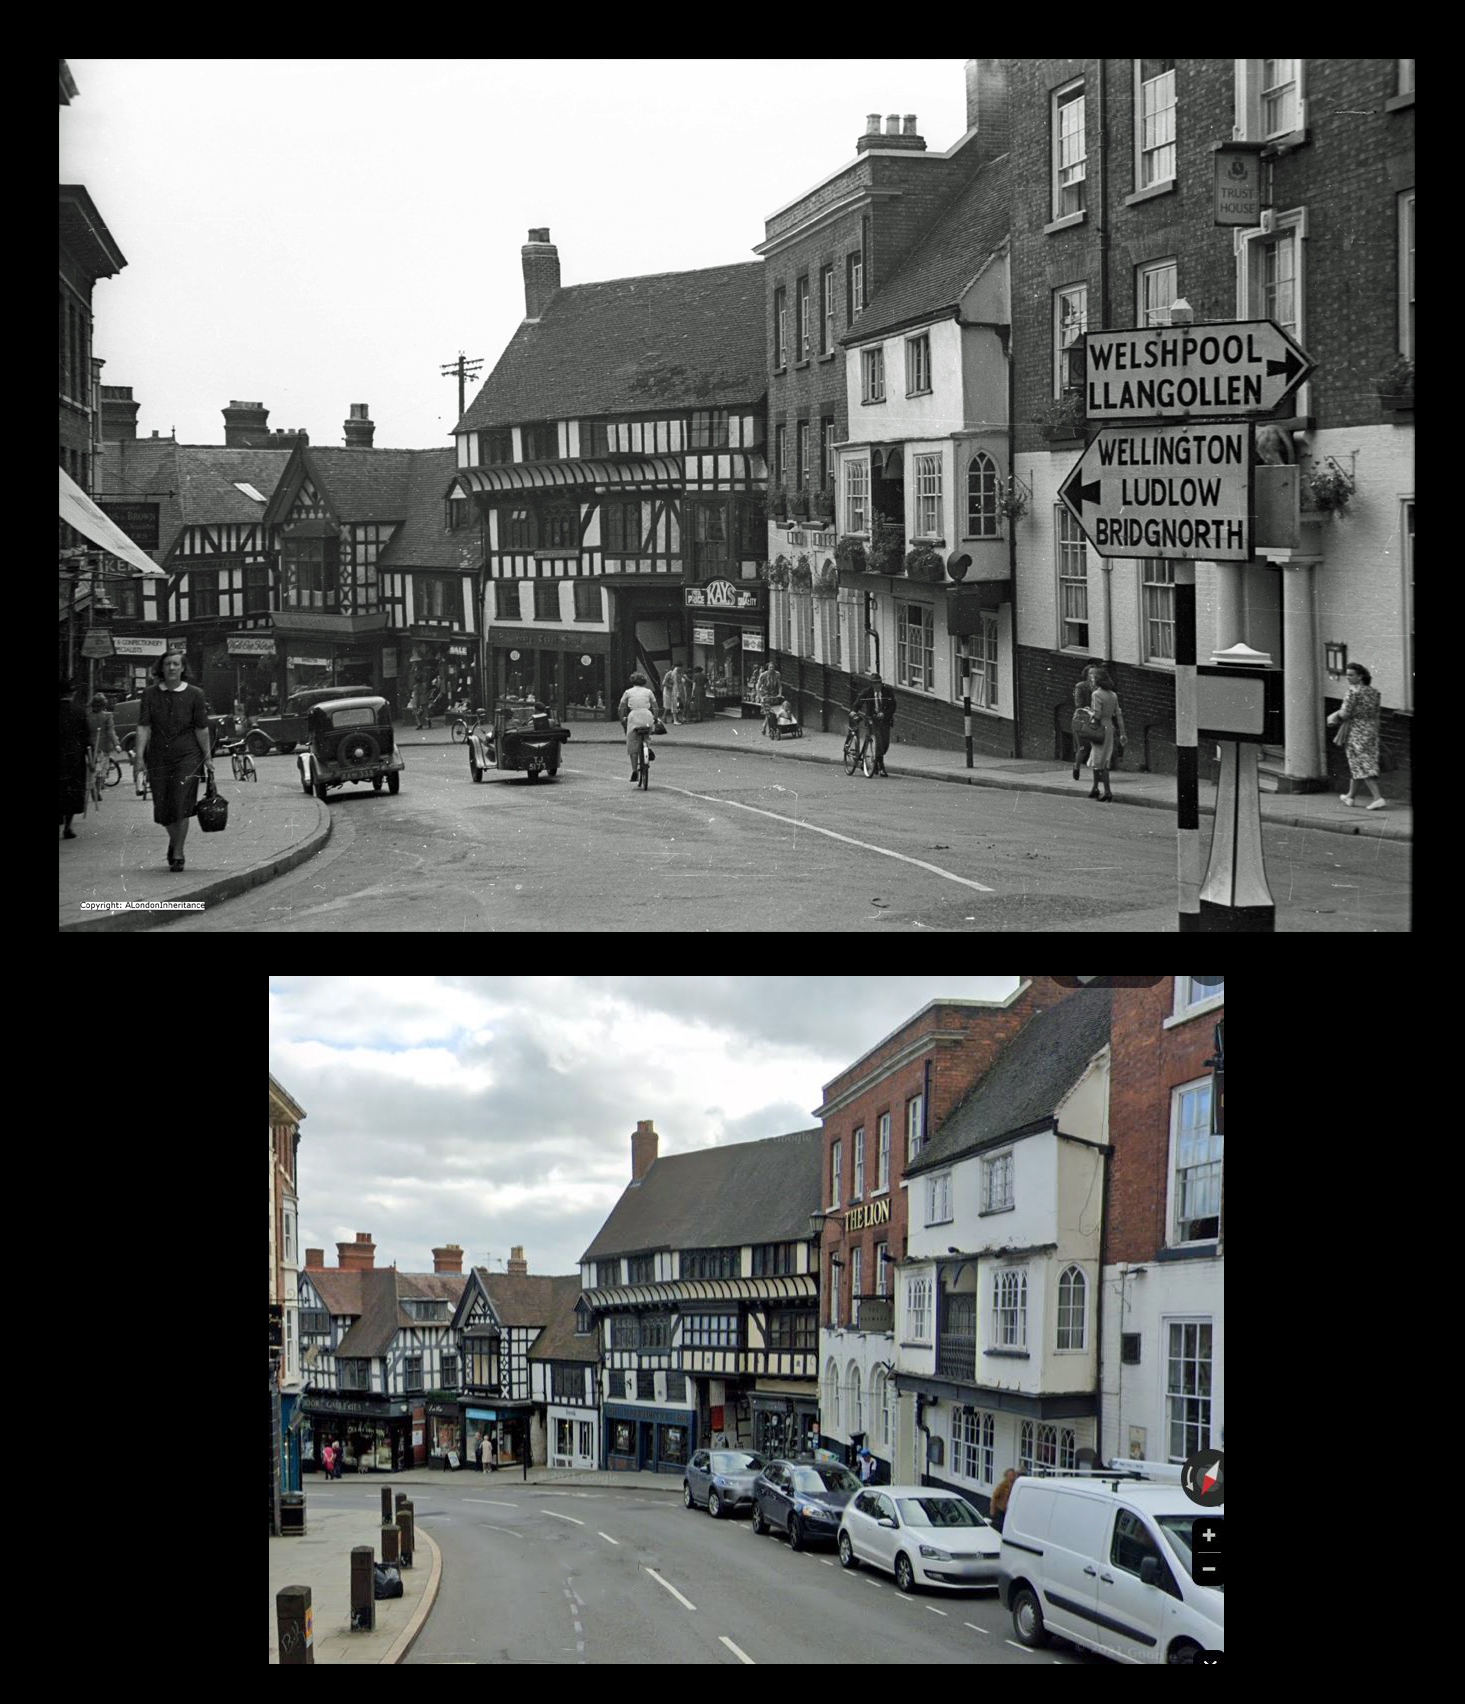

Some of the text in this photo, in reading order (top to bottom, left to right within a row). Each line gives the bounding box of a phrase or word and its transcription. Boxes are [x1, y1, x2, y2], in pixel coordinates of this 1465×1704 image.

[1220, 203, 1256, 213] HOUSE
[1221, 188, 1254, 199] TRUST
[1089, 334, 1263, 371] WELSHPOOL
[1089, 375, 1262, 410] LLANGOLLEN
[1098, 434, 1242, 466] WELLINGTON
[1122, 478, 1221, 506] LUDLOW
[127, 511, 156, 521] BROWN
[1096, 518, 1244, 549] BRIDGNORTH
[122, 639, 163, 647] CONFECTIONERY
[844, 1198, 891, 1232] THE LION
